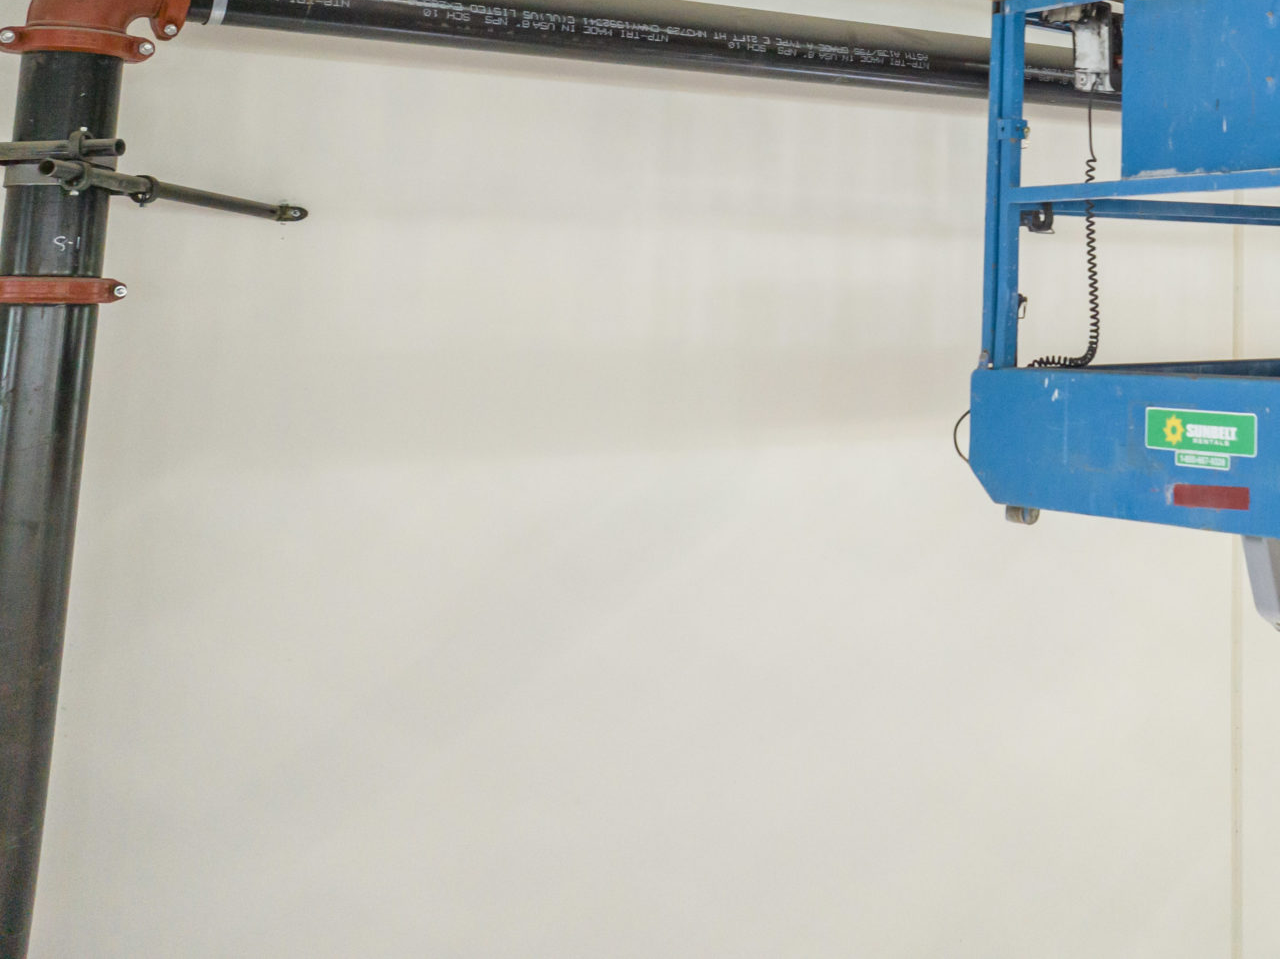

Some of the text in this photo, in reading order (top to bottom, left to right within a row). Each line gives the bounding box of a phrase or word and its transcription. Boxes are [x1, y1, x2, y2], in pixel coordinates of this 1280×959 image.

[423, 8, 438, 17] 10
[470, 3, 516, 17] LISTED
[447, 11, 471, 22] SCH
[484, 15, 508, 26] NPS
[561, 24, 575, 33] IN
[583, 25, 613, 36] MADE
[620, 29, 669, 42] NTP-TRI
[713, 31, 727, 40] HT
[732, 34, 758, 43] 21FT
[728, 41, 740, 49] 10
[747, 43, 766, 52] SCH
[775, 37, 800, 48] TYPE
[777, 46, 797, 55] NPS
[819, 52, 837, 61] USA
[860, 55, 884, 64] MADE
[905, 51, 929, 61] ASTM
[889, 58, 930, 70] NTP-TRI
[1185, 423, 1238, 441] SUNBELT
[1192, 437, 1230, 447] RENTALS
